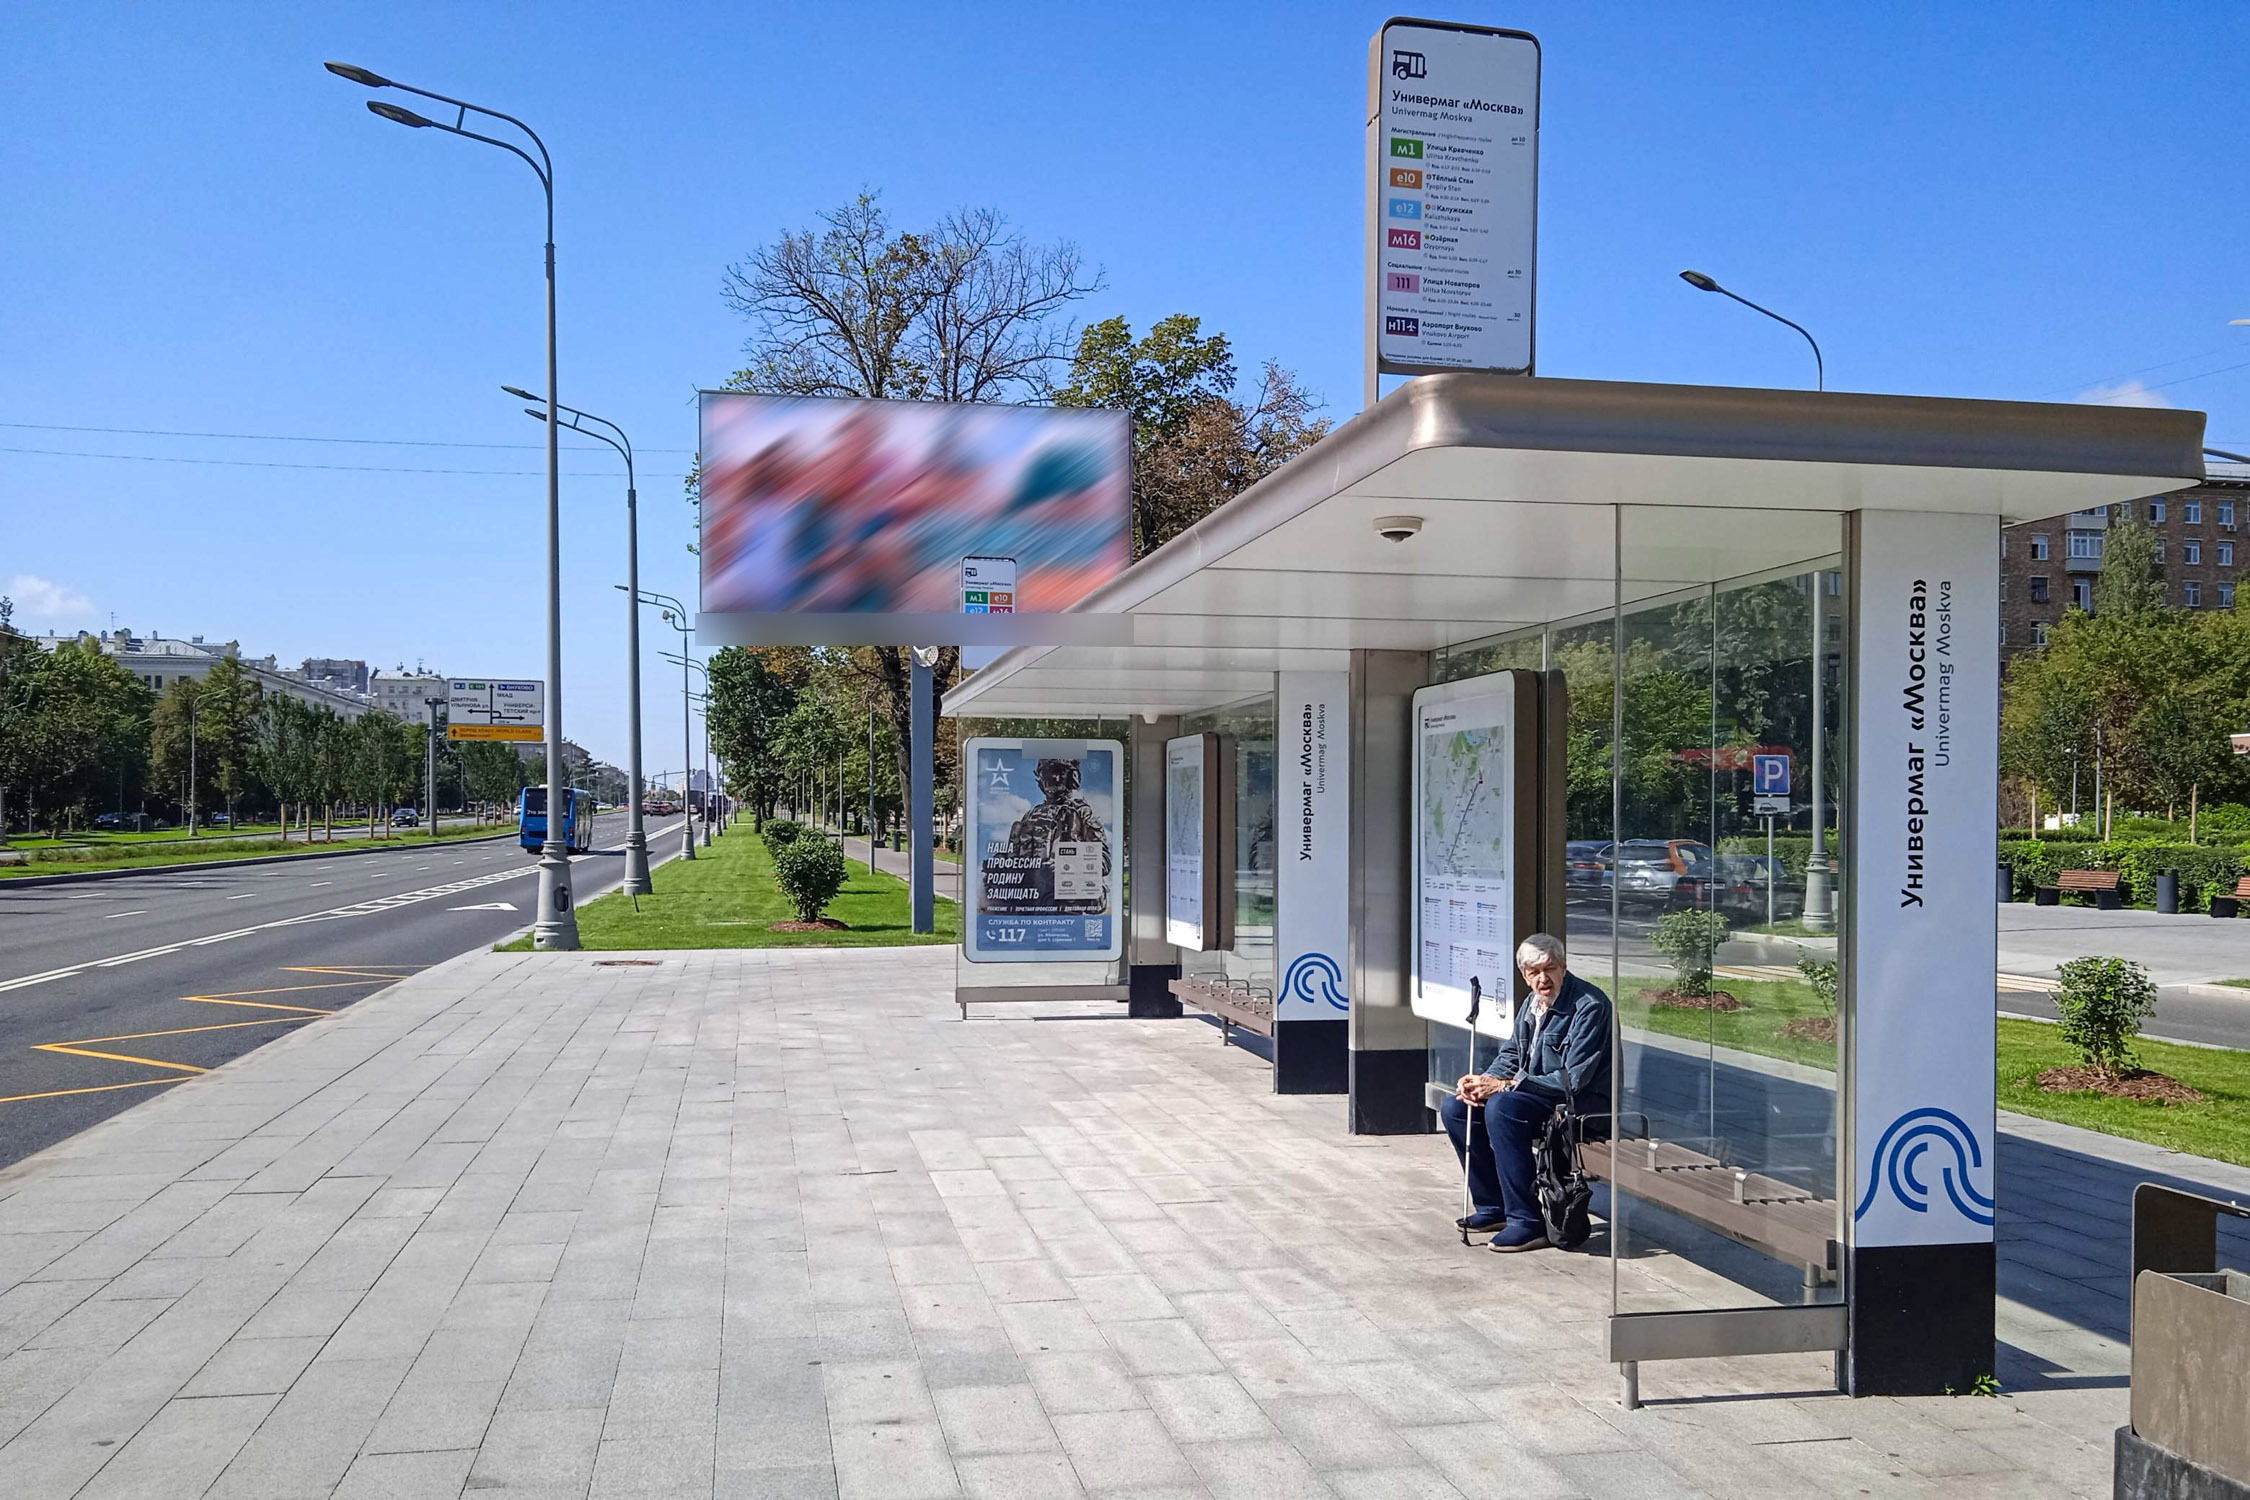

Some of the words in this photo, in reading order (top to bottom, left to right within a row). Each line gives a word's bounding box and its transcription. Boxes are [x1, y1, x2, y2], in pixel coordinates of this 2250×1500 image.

[1392, 89, 1460, 108] Универмаг
[1463, 99, 1524, 115] «Москва»
[1391, 106, 1438, 121] Univermag
[1440, 112, 1473, 123] Moskva
[1391, 127, 1436, 137] Магистральные
[1397, 143, 1416, 156] м1
[1426, 143, 1447, 151] Улица
[1448, 146, 1484, 155] Кравченко
[1444, 154, 1479, 164] Kravchenko
[1432, 174, 1457, 183] Тёплый
[1437, 205, 1473, 214] Калужская
[1425, 213, 1460, 222] Kaluzhskaya
[1392, 234, 1417, 247] м16
[1430, 234, 1459, 243] Озёрная
[1424, 243, 1454, 252] Ozyornaya
[1387, 262, 1423, 271] Социальные
[1396, 276, 1411, 289] 111
[1422, 277, 1443, 286] Улица
[1444, 279, 1480, 289] Новаторов
[1441, 288, 1471, 296] Novatorov
[1422, 321, 1454, 330] Аэропорт
[1455, 323, 1482, 332] Внуково
[1936, 580, 1952, 655] Moskva
[1903, 578, 1927, 731] «Москва»
[1934, 661, 1954, 768] Univermag
[1317, 703, 1325, 740] Moskva
[1300, 704, 1312, 776] «Москва»
[1317, 743, 1327, 794] Univermag
[1764, 760, 1783, 789] P
[1300, 781, 1314, 861] Универмаг
[1901, 743, 1928, 908] Универмаг
[987, 842, 1014, 854] НАША
[987, 857, 1042, 869] ПРОФЕССИЯ
[987, 872, 1024, 885] РОДИНУ
[987, 887, 1040, 900] ЗАЩИЩАТЬ
[998, 928, 1026, 942] 117
